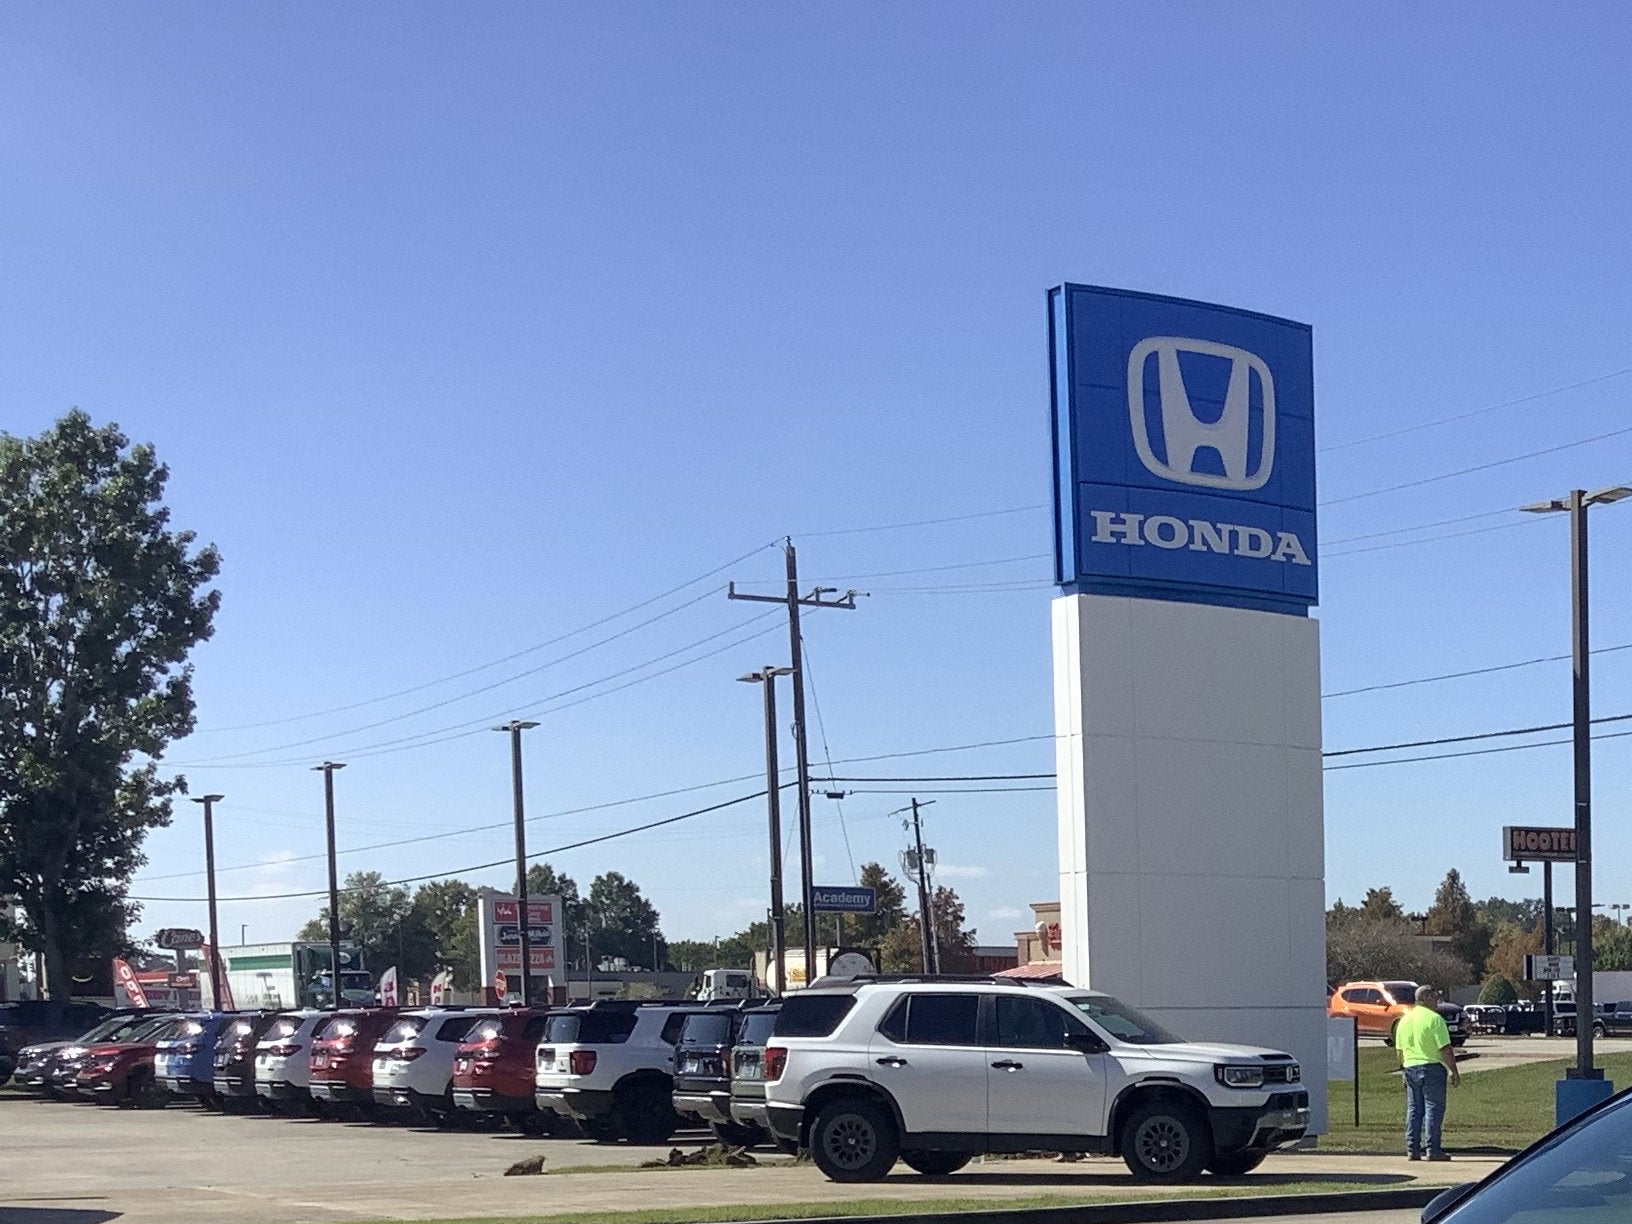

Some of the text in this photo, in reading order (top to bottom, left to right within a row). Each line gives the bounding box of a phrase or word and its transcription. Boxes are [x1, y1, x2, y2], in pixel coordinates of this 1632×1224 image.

[1090, 510, 1312, 565] HONDA
[1512, 830, 1576, 851] HOOTE
[813, 891, 871, 907] Academy
